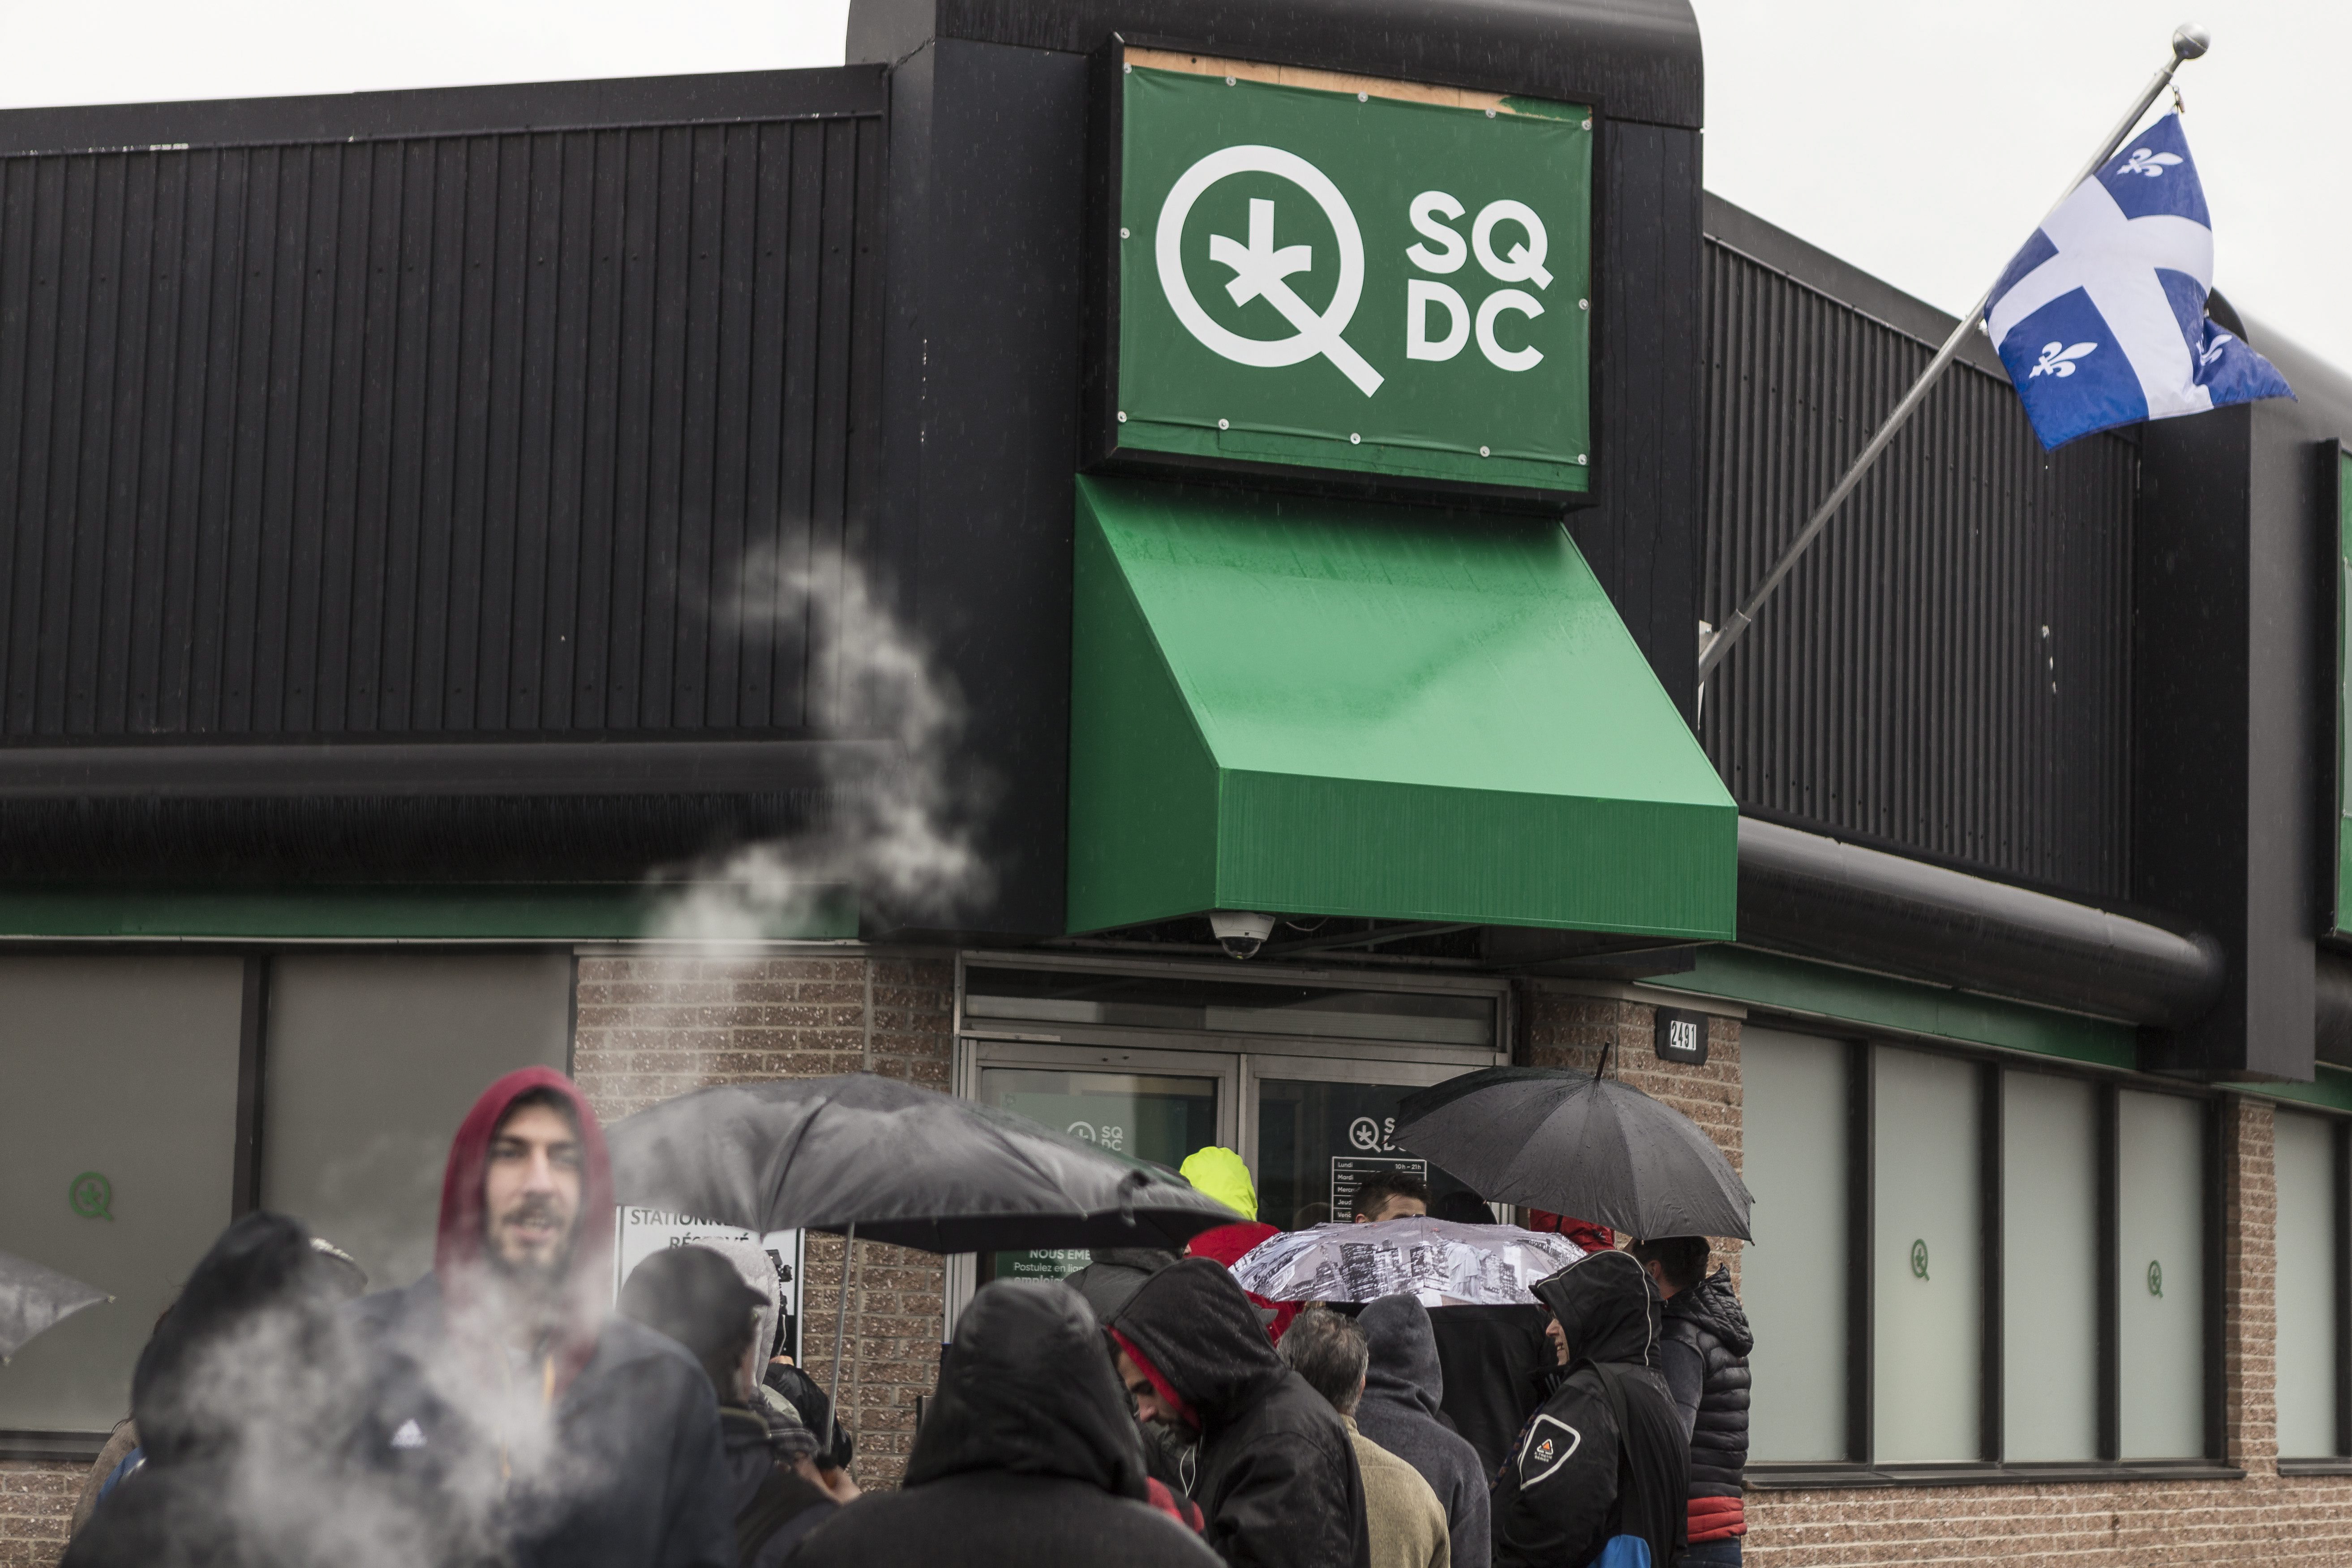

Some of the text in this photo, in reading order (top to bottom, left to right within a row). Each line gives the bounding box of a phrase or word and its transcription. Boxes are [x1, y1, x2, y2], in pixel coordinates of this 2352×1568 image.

[1406, 190, 1554, 290] SQ
[1407, 279, 1545, 371] DC
[1671, 1021, 1695, 1049] 2491
[1102, 1126, 1123, 1139] SQ
[1030, 1249, 1064, 1259] NOUS
[1014, 1262, 1052, 1272] Postulez
